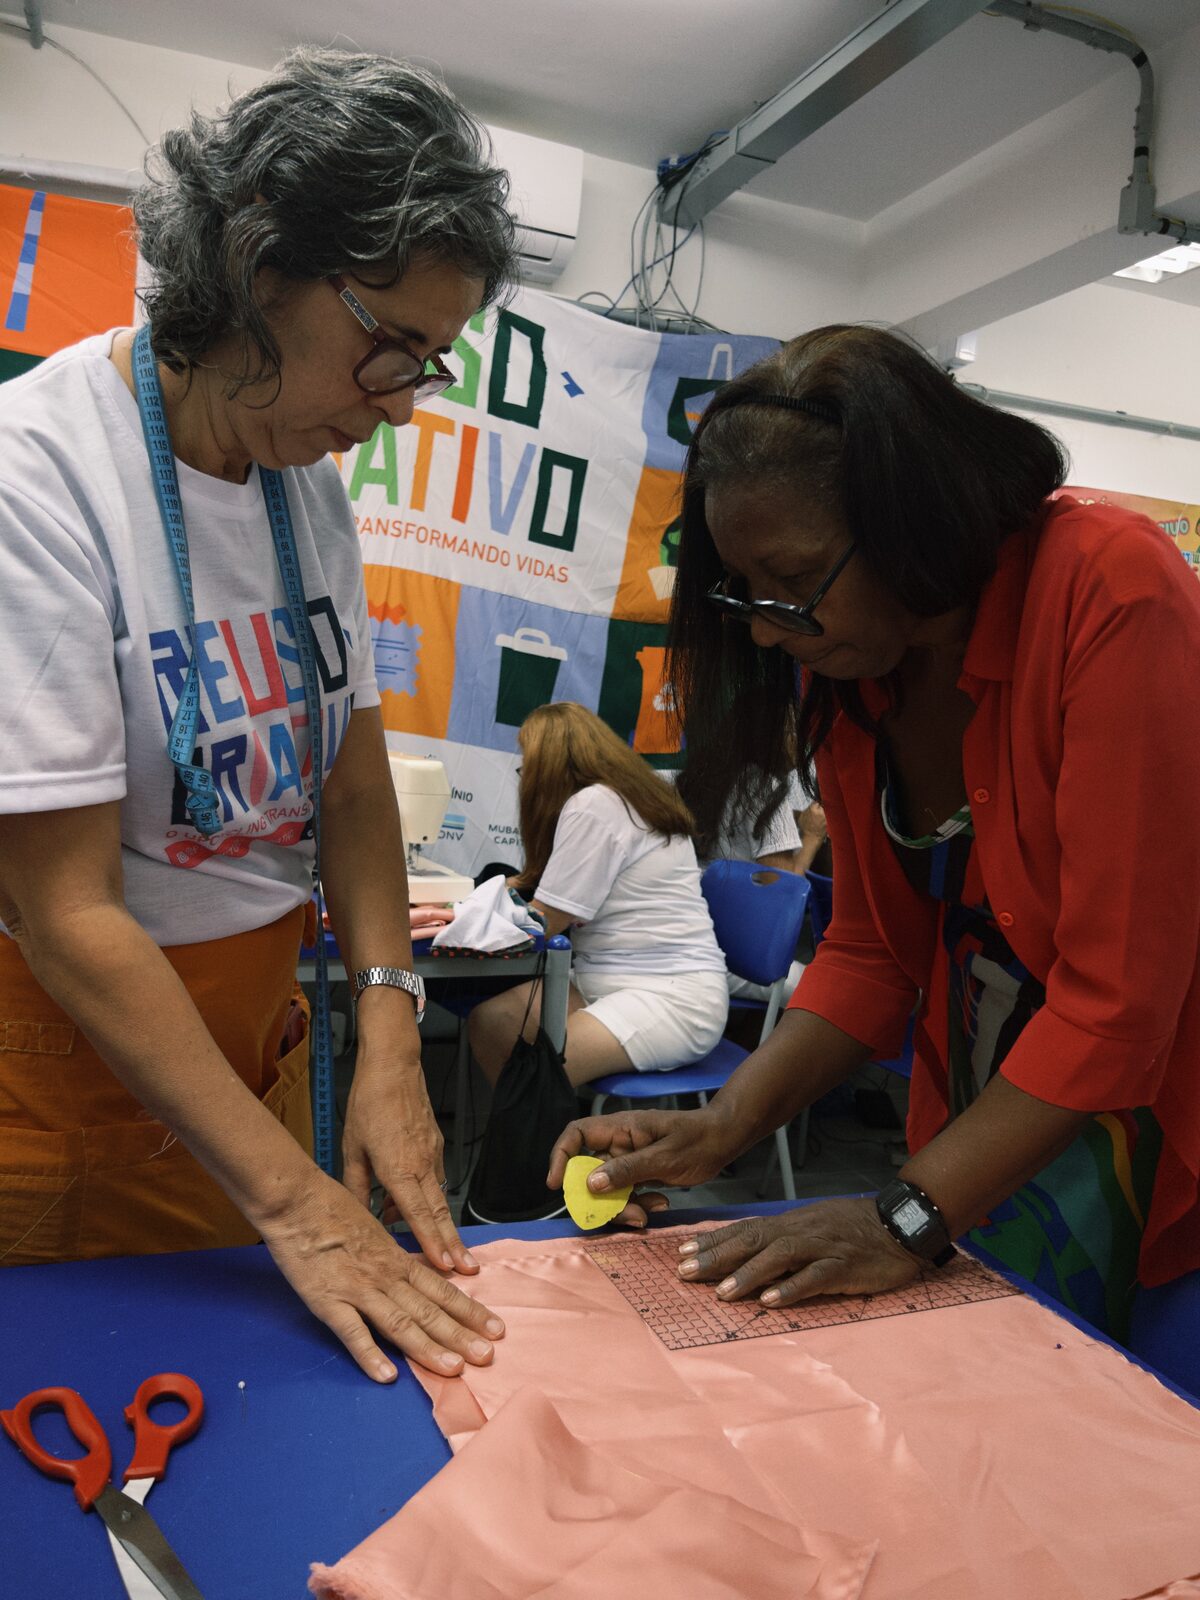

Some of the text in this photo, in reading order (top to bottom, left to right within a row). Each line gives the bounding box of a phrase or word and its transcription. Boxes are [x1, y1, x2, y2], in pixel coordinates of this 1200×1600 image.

[139, 368, 153, 378] 110
[142, 382, 156, 393] 111
[144, 396, 159, 407] 112
[147, 411, 162, 421] 113
[150, 426, 165, 436] 114
[153, 440, 168, 451] 115
[157, 455, 171, 465] 116
[160, 470, 172, 480] 117
[331, 409, 588, 553] ATIVO
[516, 554, 569, 583] VIDAS
[149, 596, 348, 737] REUSO
[186, 697, 194, 707] 18
[182, 711, 191, 721] 17
[178, 725, 188, 735] 16
[174, 740, 184, 749] 15
[172, 751, 180, 761] 14
[184, 769, 194, 785] 139
[198, 774, 209, 788] 140
